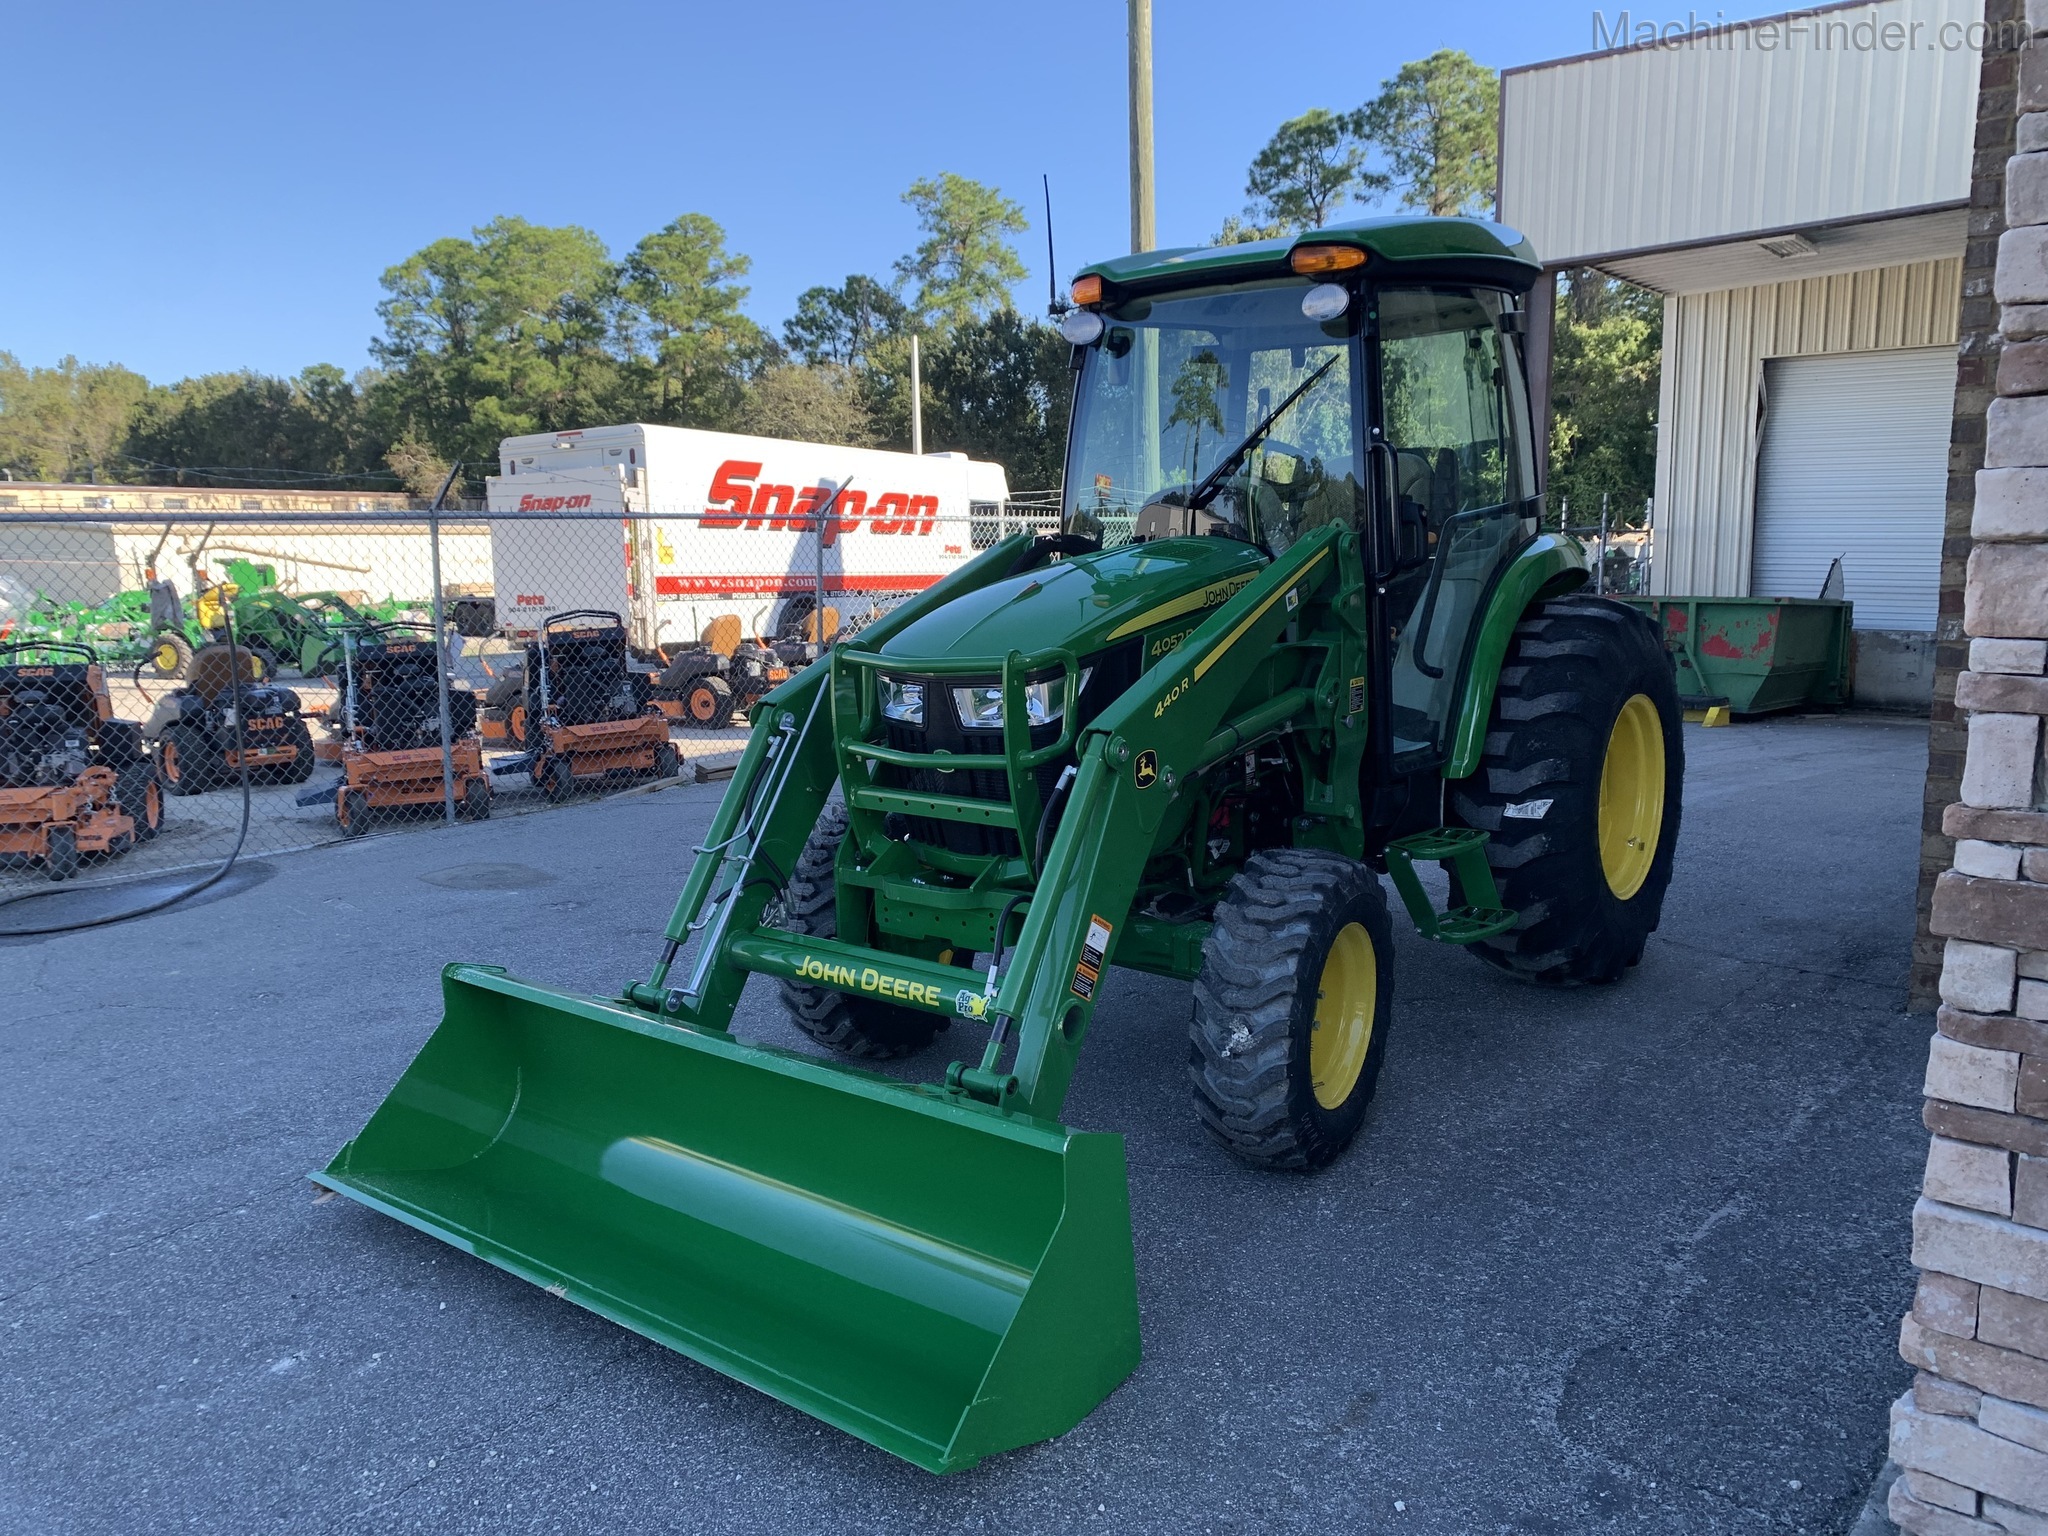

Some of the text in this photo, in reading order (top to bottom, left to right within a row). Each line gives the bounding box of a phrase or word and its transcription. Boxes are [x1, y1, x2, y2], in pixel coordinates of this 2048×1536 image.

[518, 493, 592, 512] Snap-on
[698, 460, 939, 548] Snap-on
[678, 577, 817, 590] www.snapon.com
[1203, 577, 1255, 607] JOHN DEE
[517, 594, 544, 605] Pete
[572, 630, 600, 639] SCAG
[386, 644, 417, 653] SCAG
[17, 667, 55, 677] SCAG
[769, 667, 789, 681] SCAG
[248, 716, 284, 731] SCAG
[795, 955, 942, 1007] JOHN DEERE
[957, 1002, 974, 1013] Pro
